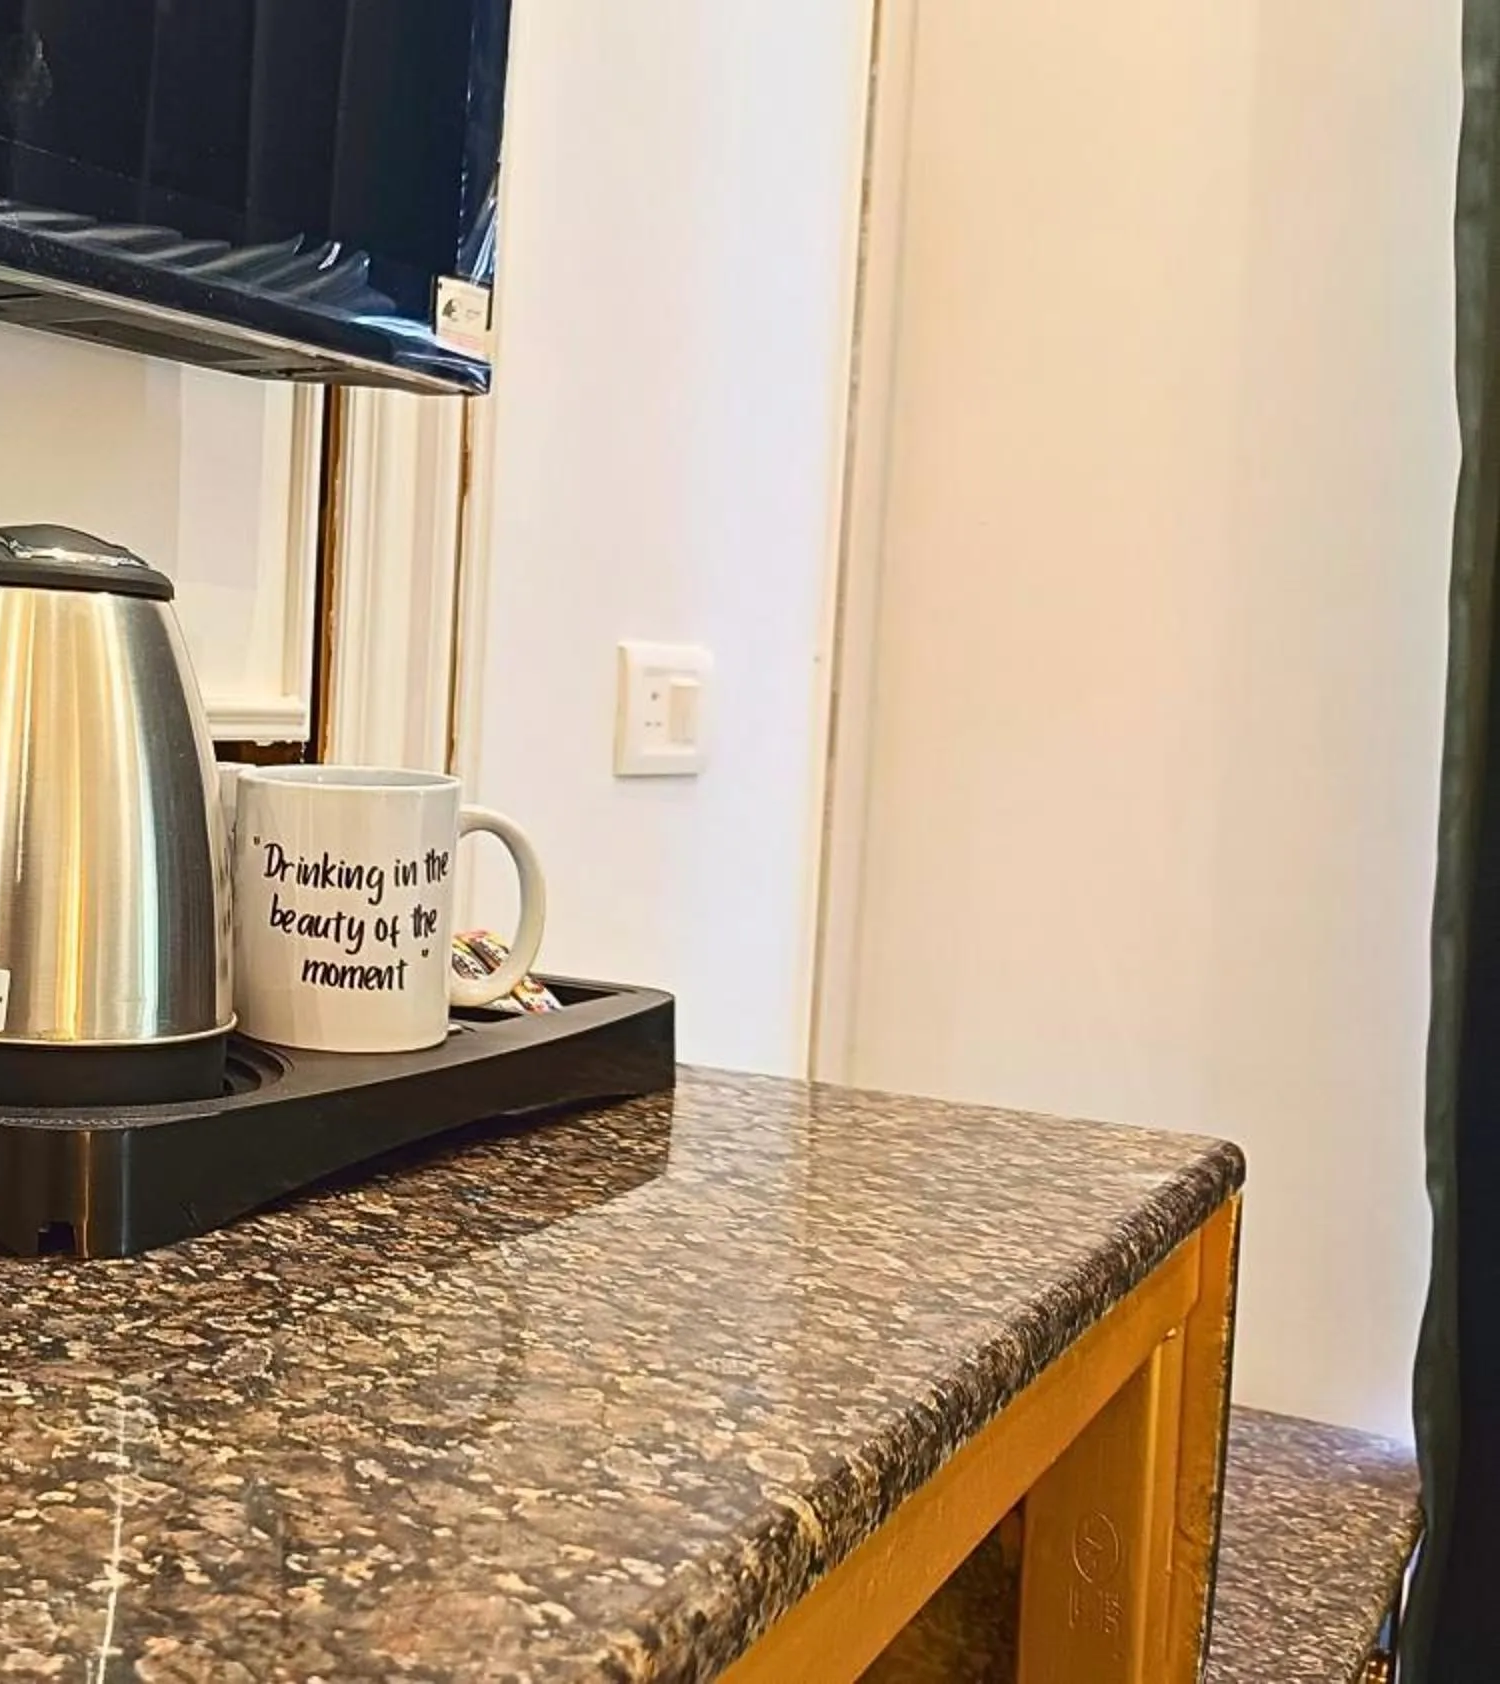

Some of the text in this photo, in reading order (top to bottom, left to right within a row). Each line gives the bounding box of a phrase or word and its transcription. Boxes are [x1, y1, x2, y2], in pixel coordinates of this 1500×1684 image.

[394, 853, 418, 887] in
[425, 848, 449, 884] the
[270, 894, 437, 955] beauty of the
